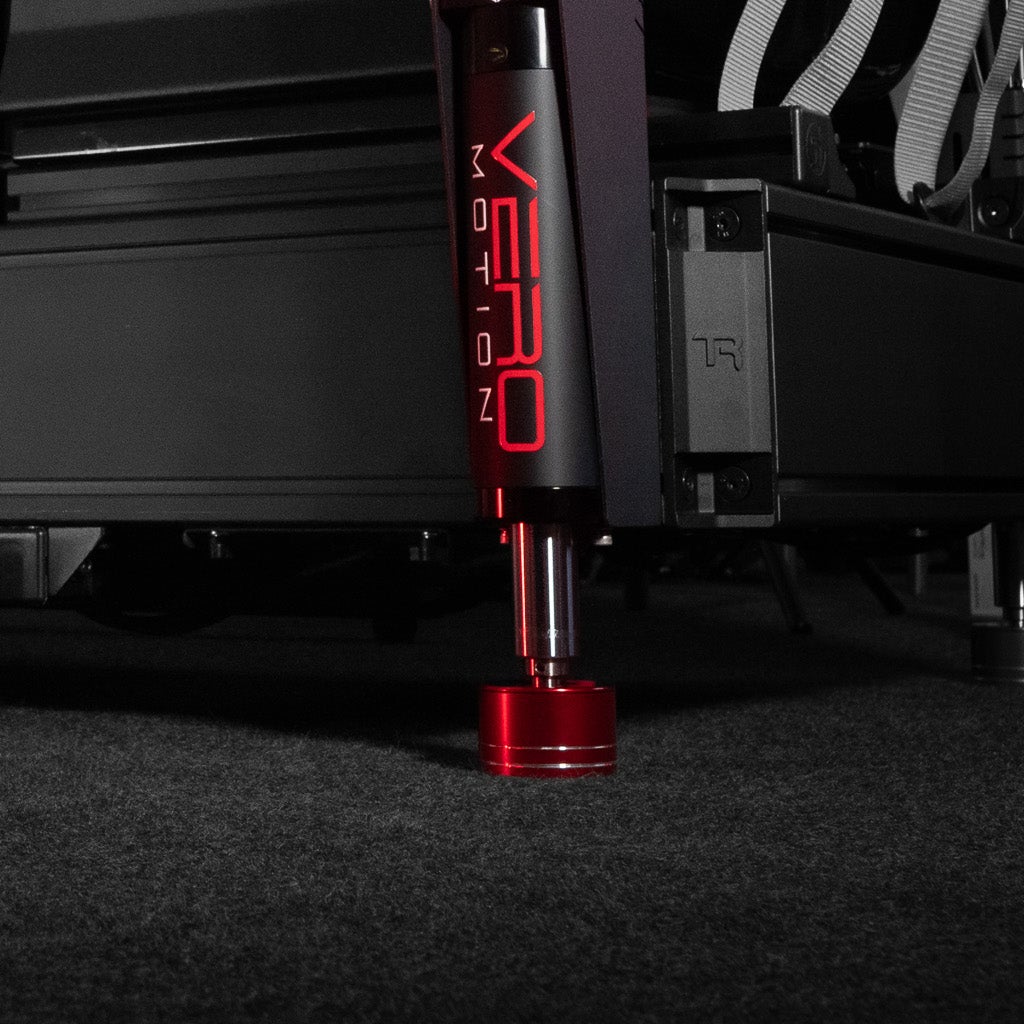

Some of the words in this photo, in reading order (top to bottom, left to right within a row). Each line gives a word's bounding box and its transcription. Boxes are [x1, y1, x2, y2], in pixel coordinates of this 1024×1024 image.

[471, 143, 493, 423] MOTION
[490, 110, 545, 452] VERO
[692, 328, 744, 372] TR
